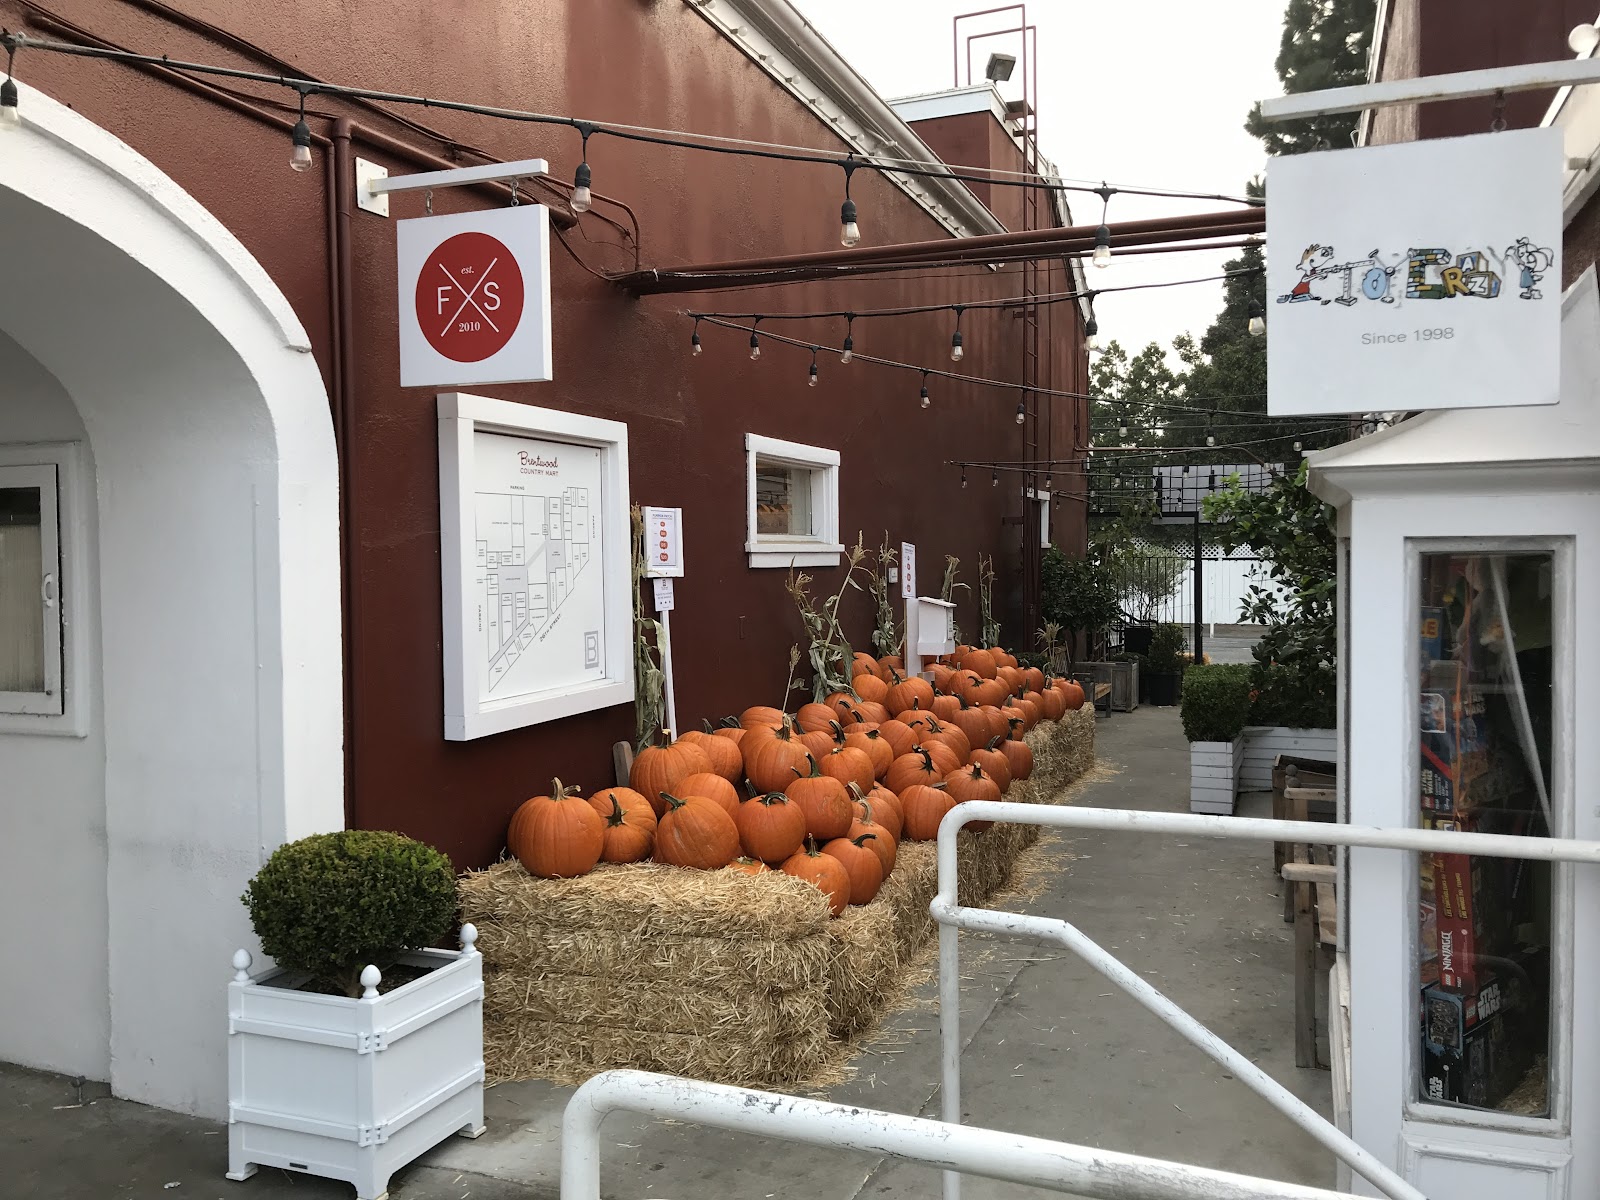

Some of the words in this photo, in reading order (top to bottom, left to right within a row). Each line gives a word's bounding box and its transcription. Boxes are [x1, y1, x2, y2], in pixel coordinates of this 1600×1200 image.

[461, 265, 475, 275] est.
[458, 321, 481, 333] 2010
[1361, 330, 1407, 345] Since
[1412, 326, 1455, 342] 1998
[517, 450, 559, 468] Brentwood
[519, 467, 544, 476] COUNTRY
[549, 613, 562, 631] STREET
[586, 635, 597, 663] B
[1441, 930, 1455, 973] NINJAGO
[1479, 983, 1501, 1005] STAR
[1477, 998, 1501, 1021] WARS
[1435, 1076, 1444, 1099] ARS
